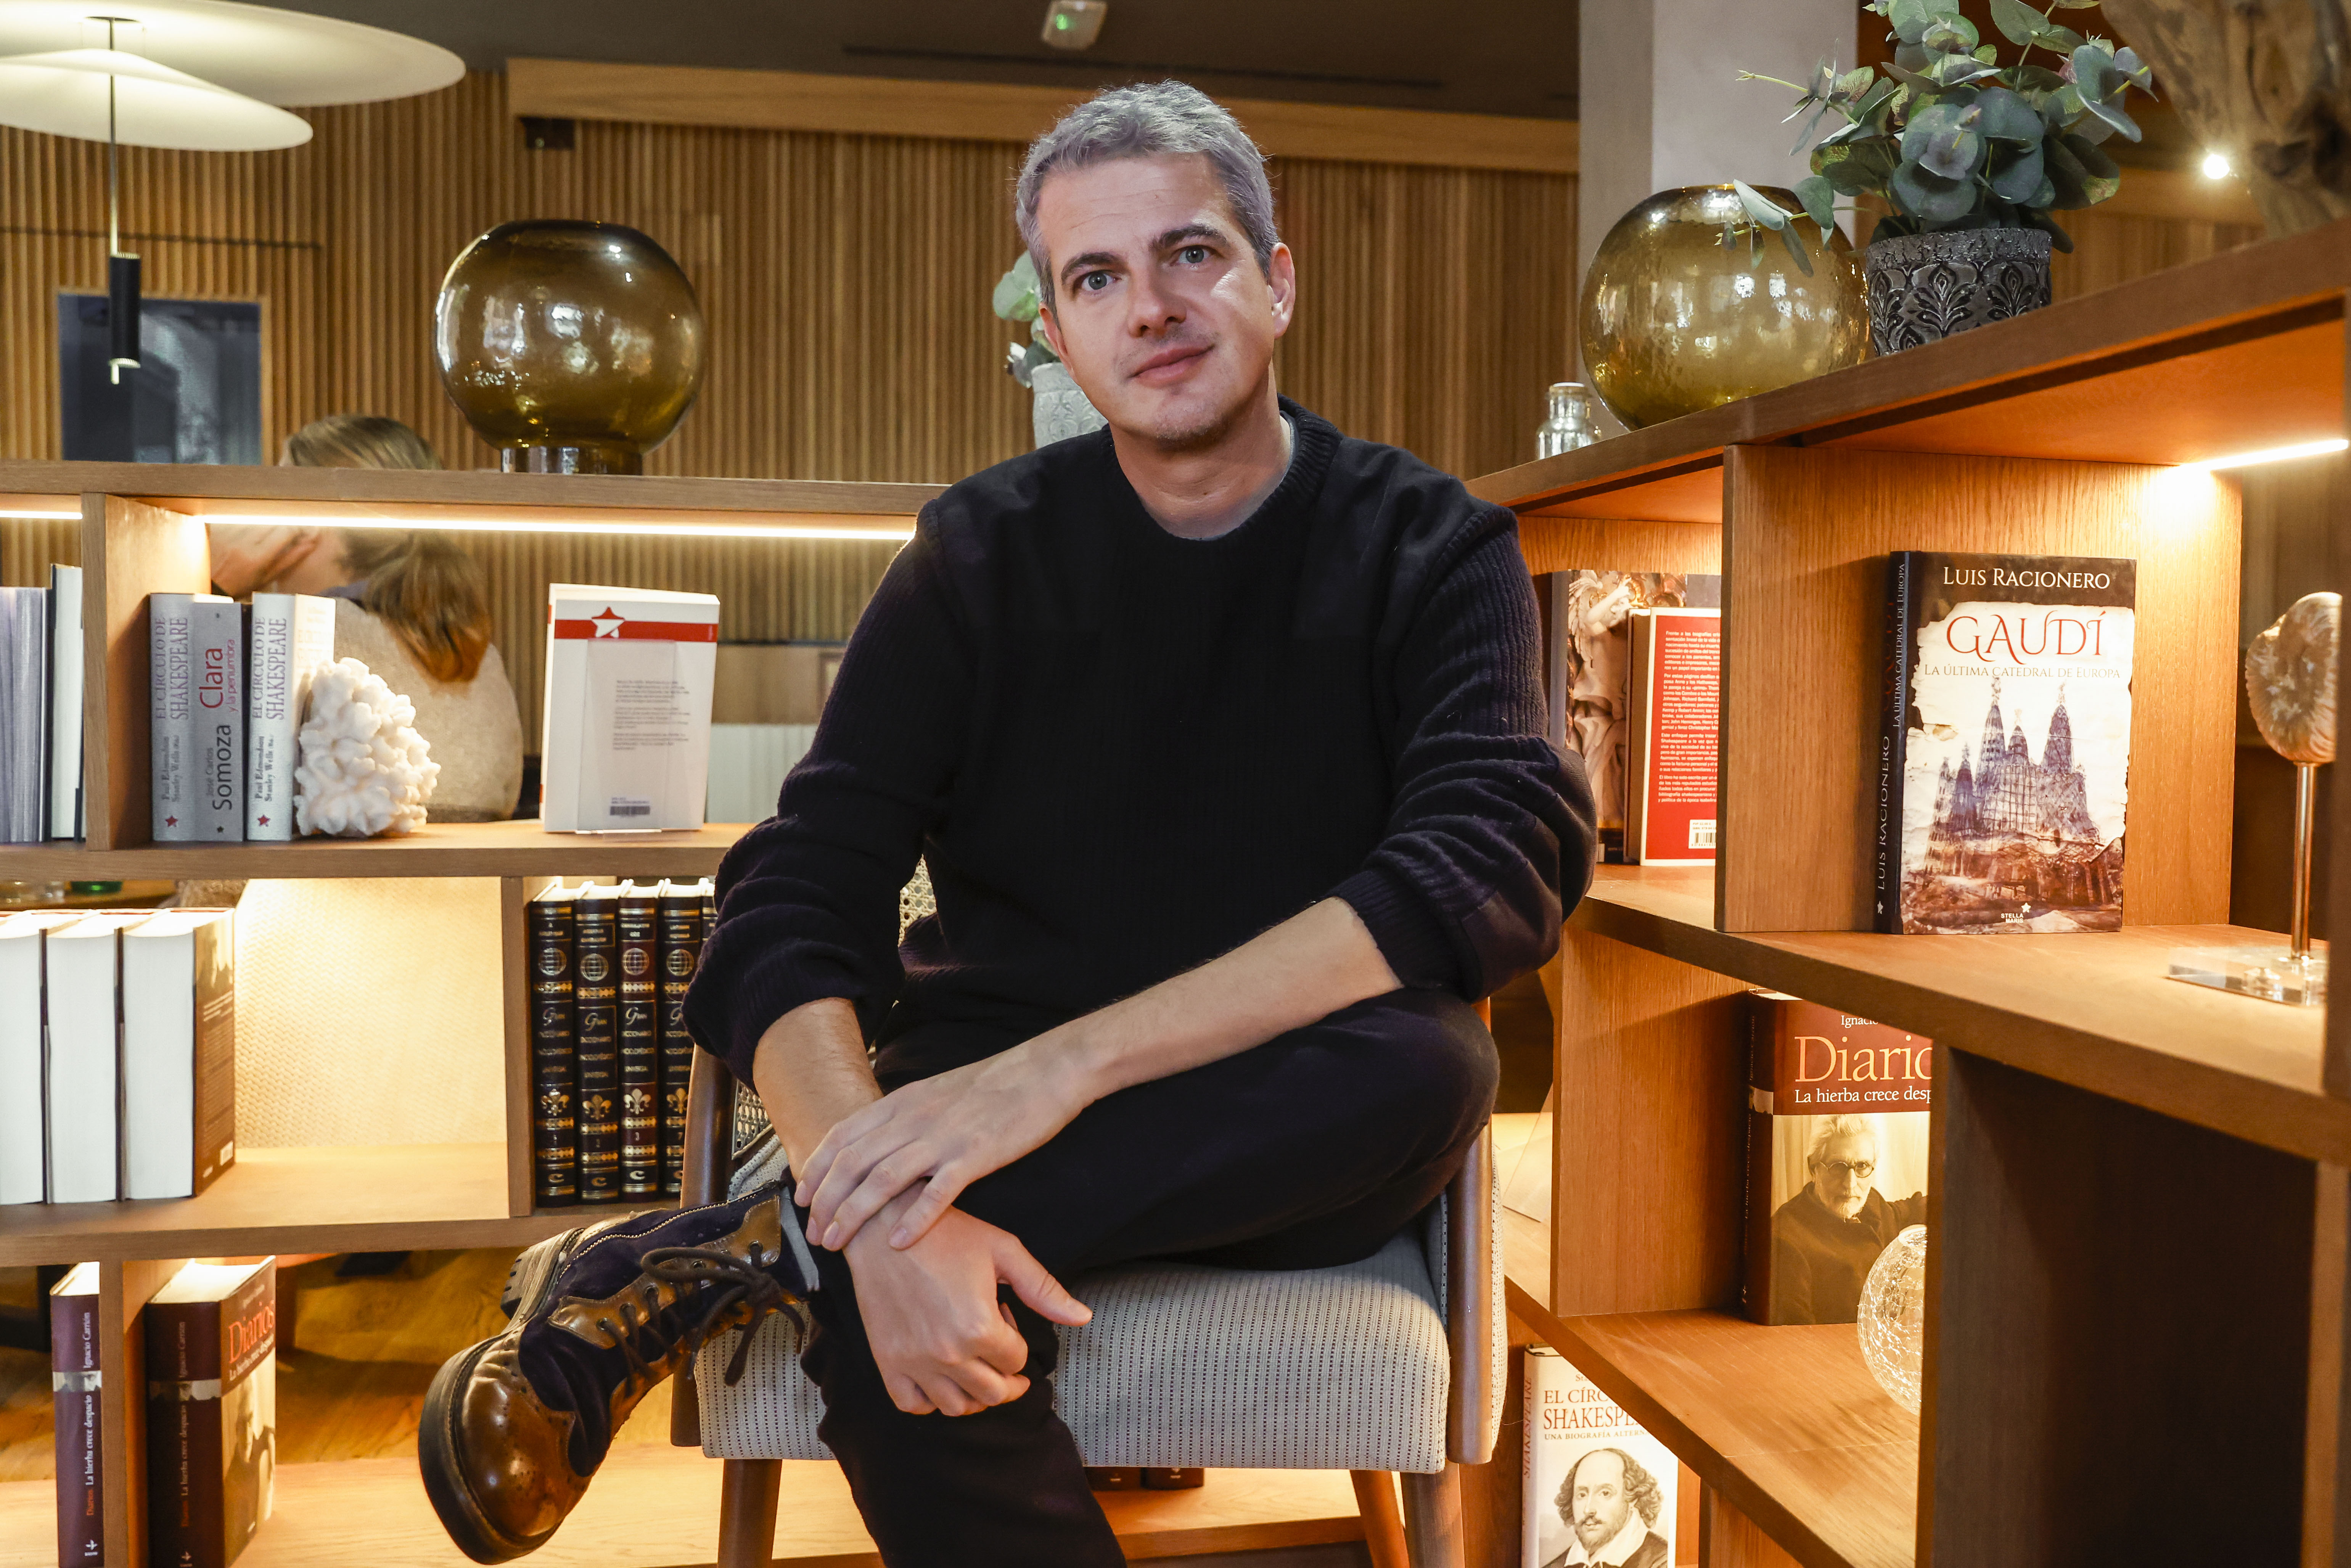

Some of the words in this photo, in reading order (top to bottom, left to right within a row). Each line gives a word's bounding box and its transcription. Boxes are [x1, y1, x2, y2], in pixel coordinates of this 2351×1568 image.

[1943, 567, 1986, 586] LUIS
[1993, 568, 2110, 589] RACIONERO
[255, 617, 265, 635] DE
[1946, 610, 2106, 664] GAUDÍ
[170, 618, 189, 720] SHAKESPEARE
[199, 648, 223, 708] Clara
[226, 639, 238, 694] penumbra
[267, 618, 286, 720] SHAKESPEARE
[226, 696, 236, 704] la
[252, 704, 262, 719] EL
[212, 725, 232, 810] Somoza
[1879, 736, 1889, 846] RACIONERO
[1878, 851, 1886, 890] LUIS
[1795, 1089, 1811, 1103] La
[1816, 1087, 1860, 1102] hierba
[1864, 1090, 1899, 1102] crece
[1544, 1390, 1563, 1403] EL
[1544, 1406, 1639, 1429] SHAKESPE
[1565, 1430, 1611, 1439] BIOGRAFÍA
[85, 1475, 94, 1486] La
